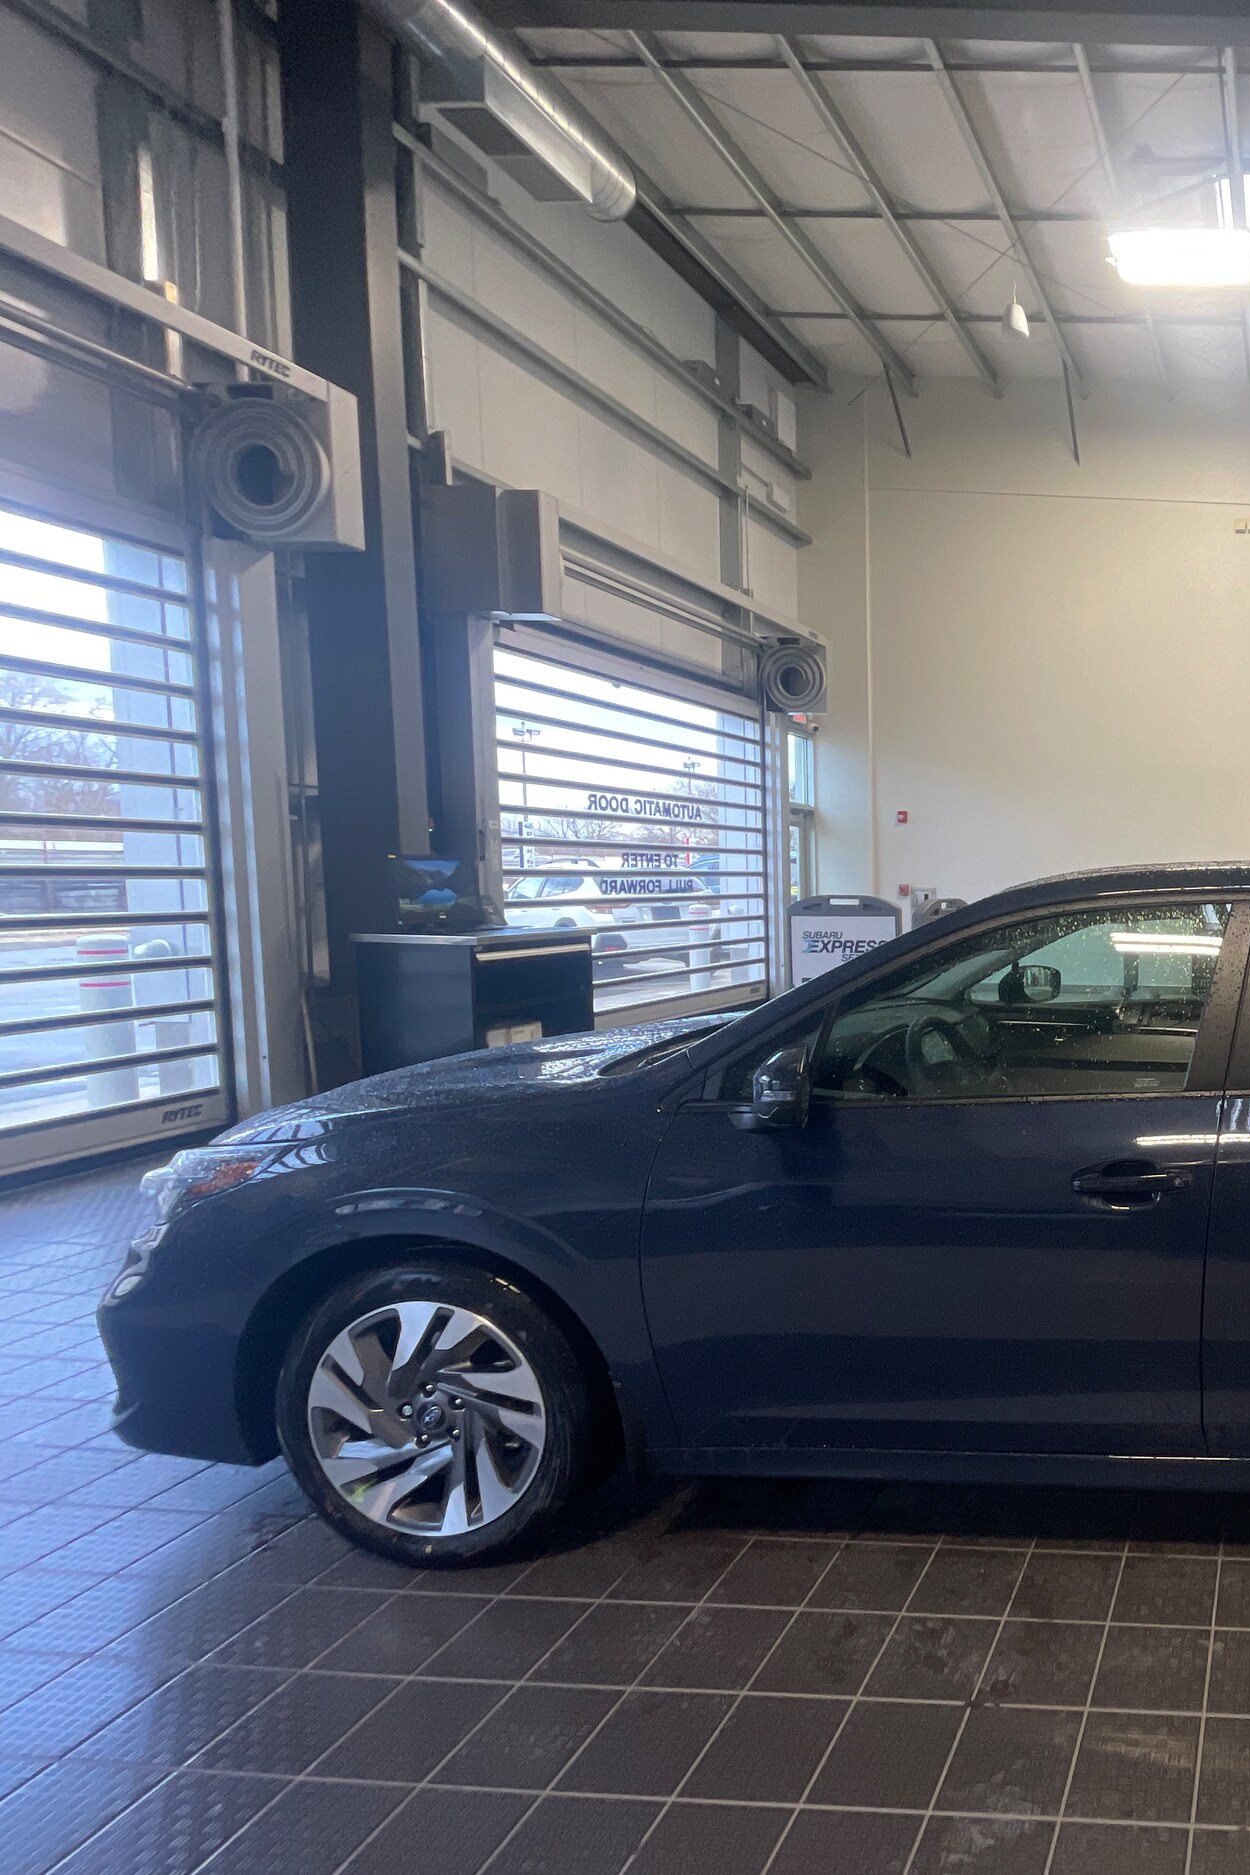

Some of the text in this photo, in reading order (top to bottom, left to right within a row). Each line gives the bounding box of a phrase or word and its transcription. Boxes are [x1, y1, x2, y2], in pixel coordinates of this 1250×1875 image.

[251, 350, 290, 378] RYTEC
[802, 931, 843, 940] SUBARU
[161, 1104, 204, 1124] RYTEC
